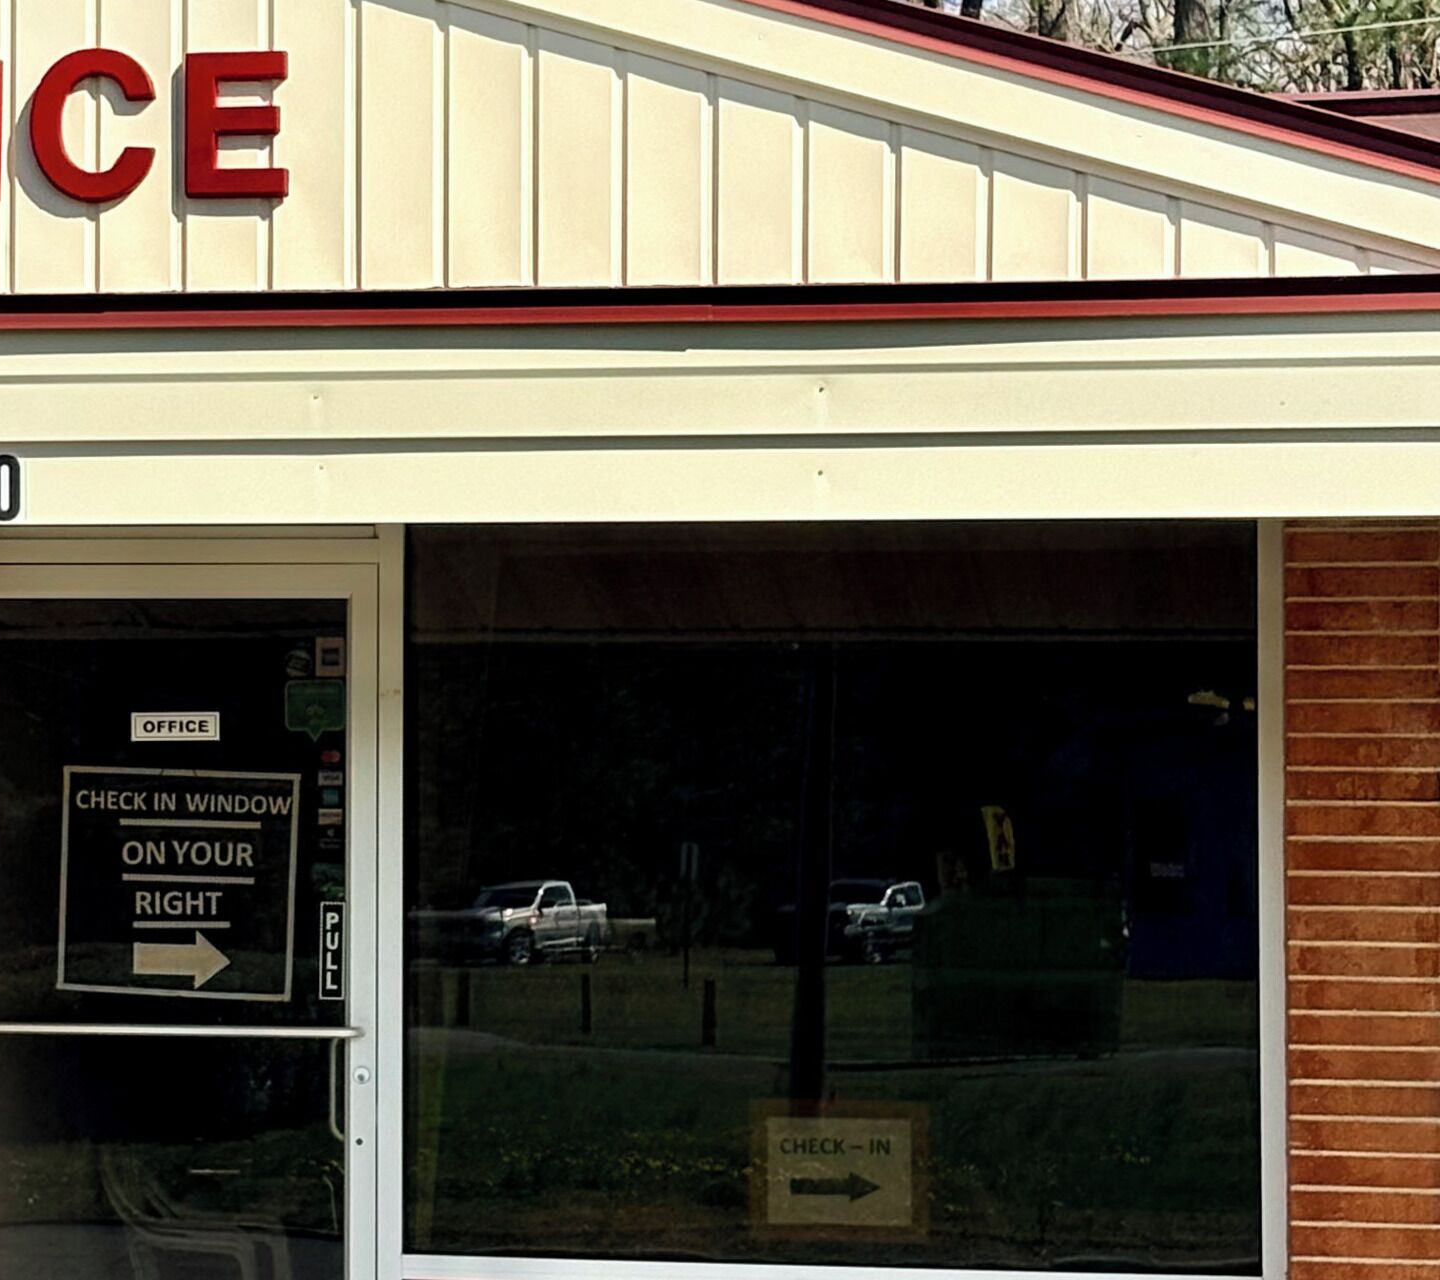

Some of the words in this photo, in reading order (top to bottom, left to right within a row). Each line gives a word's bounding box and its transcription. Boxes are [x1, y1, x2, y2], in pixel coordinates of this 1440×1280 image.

[142, 719, 210, 734] OFFICE
[76, 789, 147, 811] CHECK
[153, 791, 176, 811] IN
[186, 792, 292, 815] WINDOW
[121, 840, 165, 866] ON
[172, 841, 254, 867] YOUR
[135, 890, 223, 916] RIGHT
[325, 911, 340, 991] PULL
